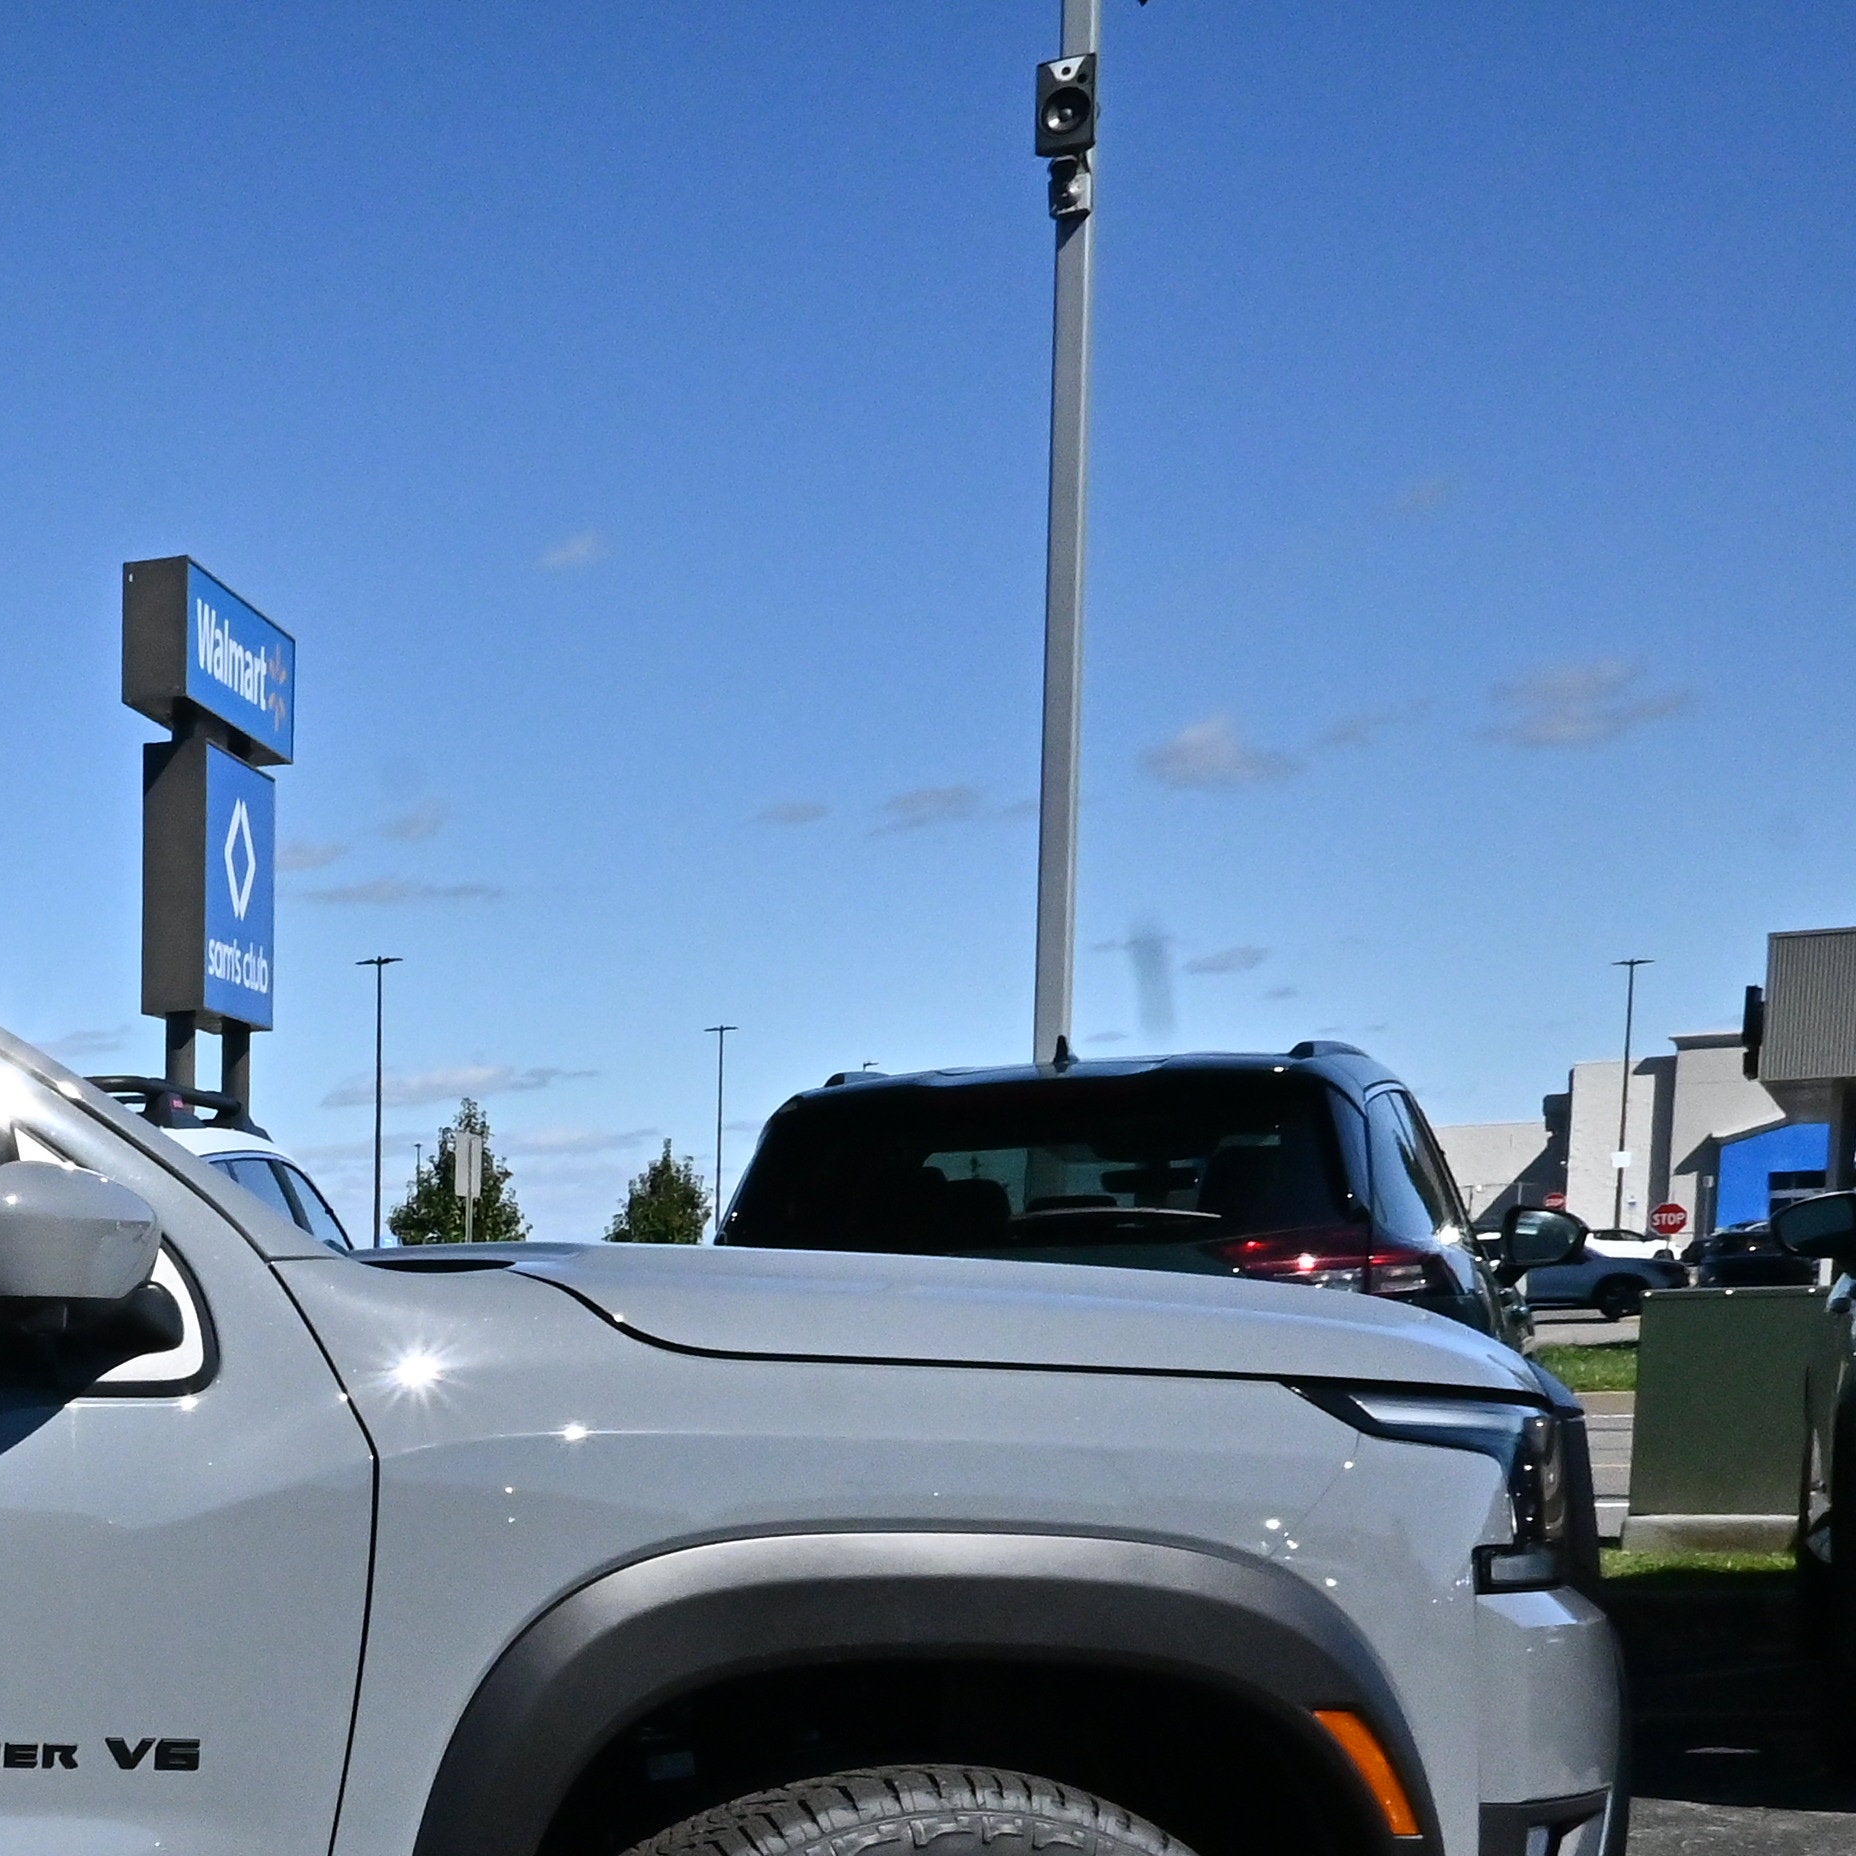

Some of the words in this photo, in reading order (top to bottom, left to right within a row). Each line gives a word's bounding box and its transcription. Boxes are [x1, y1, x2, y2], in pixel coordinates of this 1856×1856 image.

[196, 597, 267, 712] Walmart
[242, 941, 269, 994] club
[1651, 1212, 1686, 1226] STOP
[105, 1737, 201, 1771] V6
